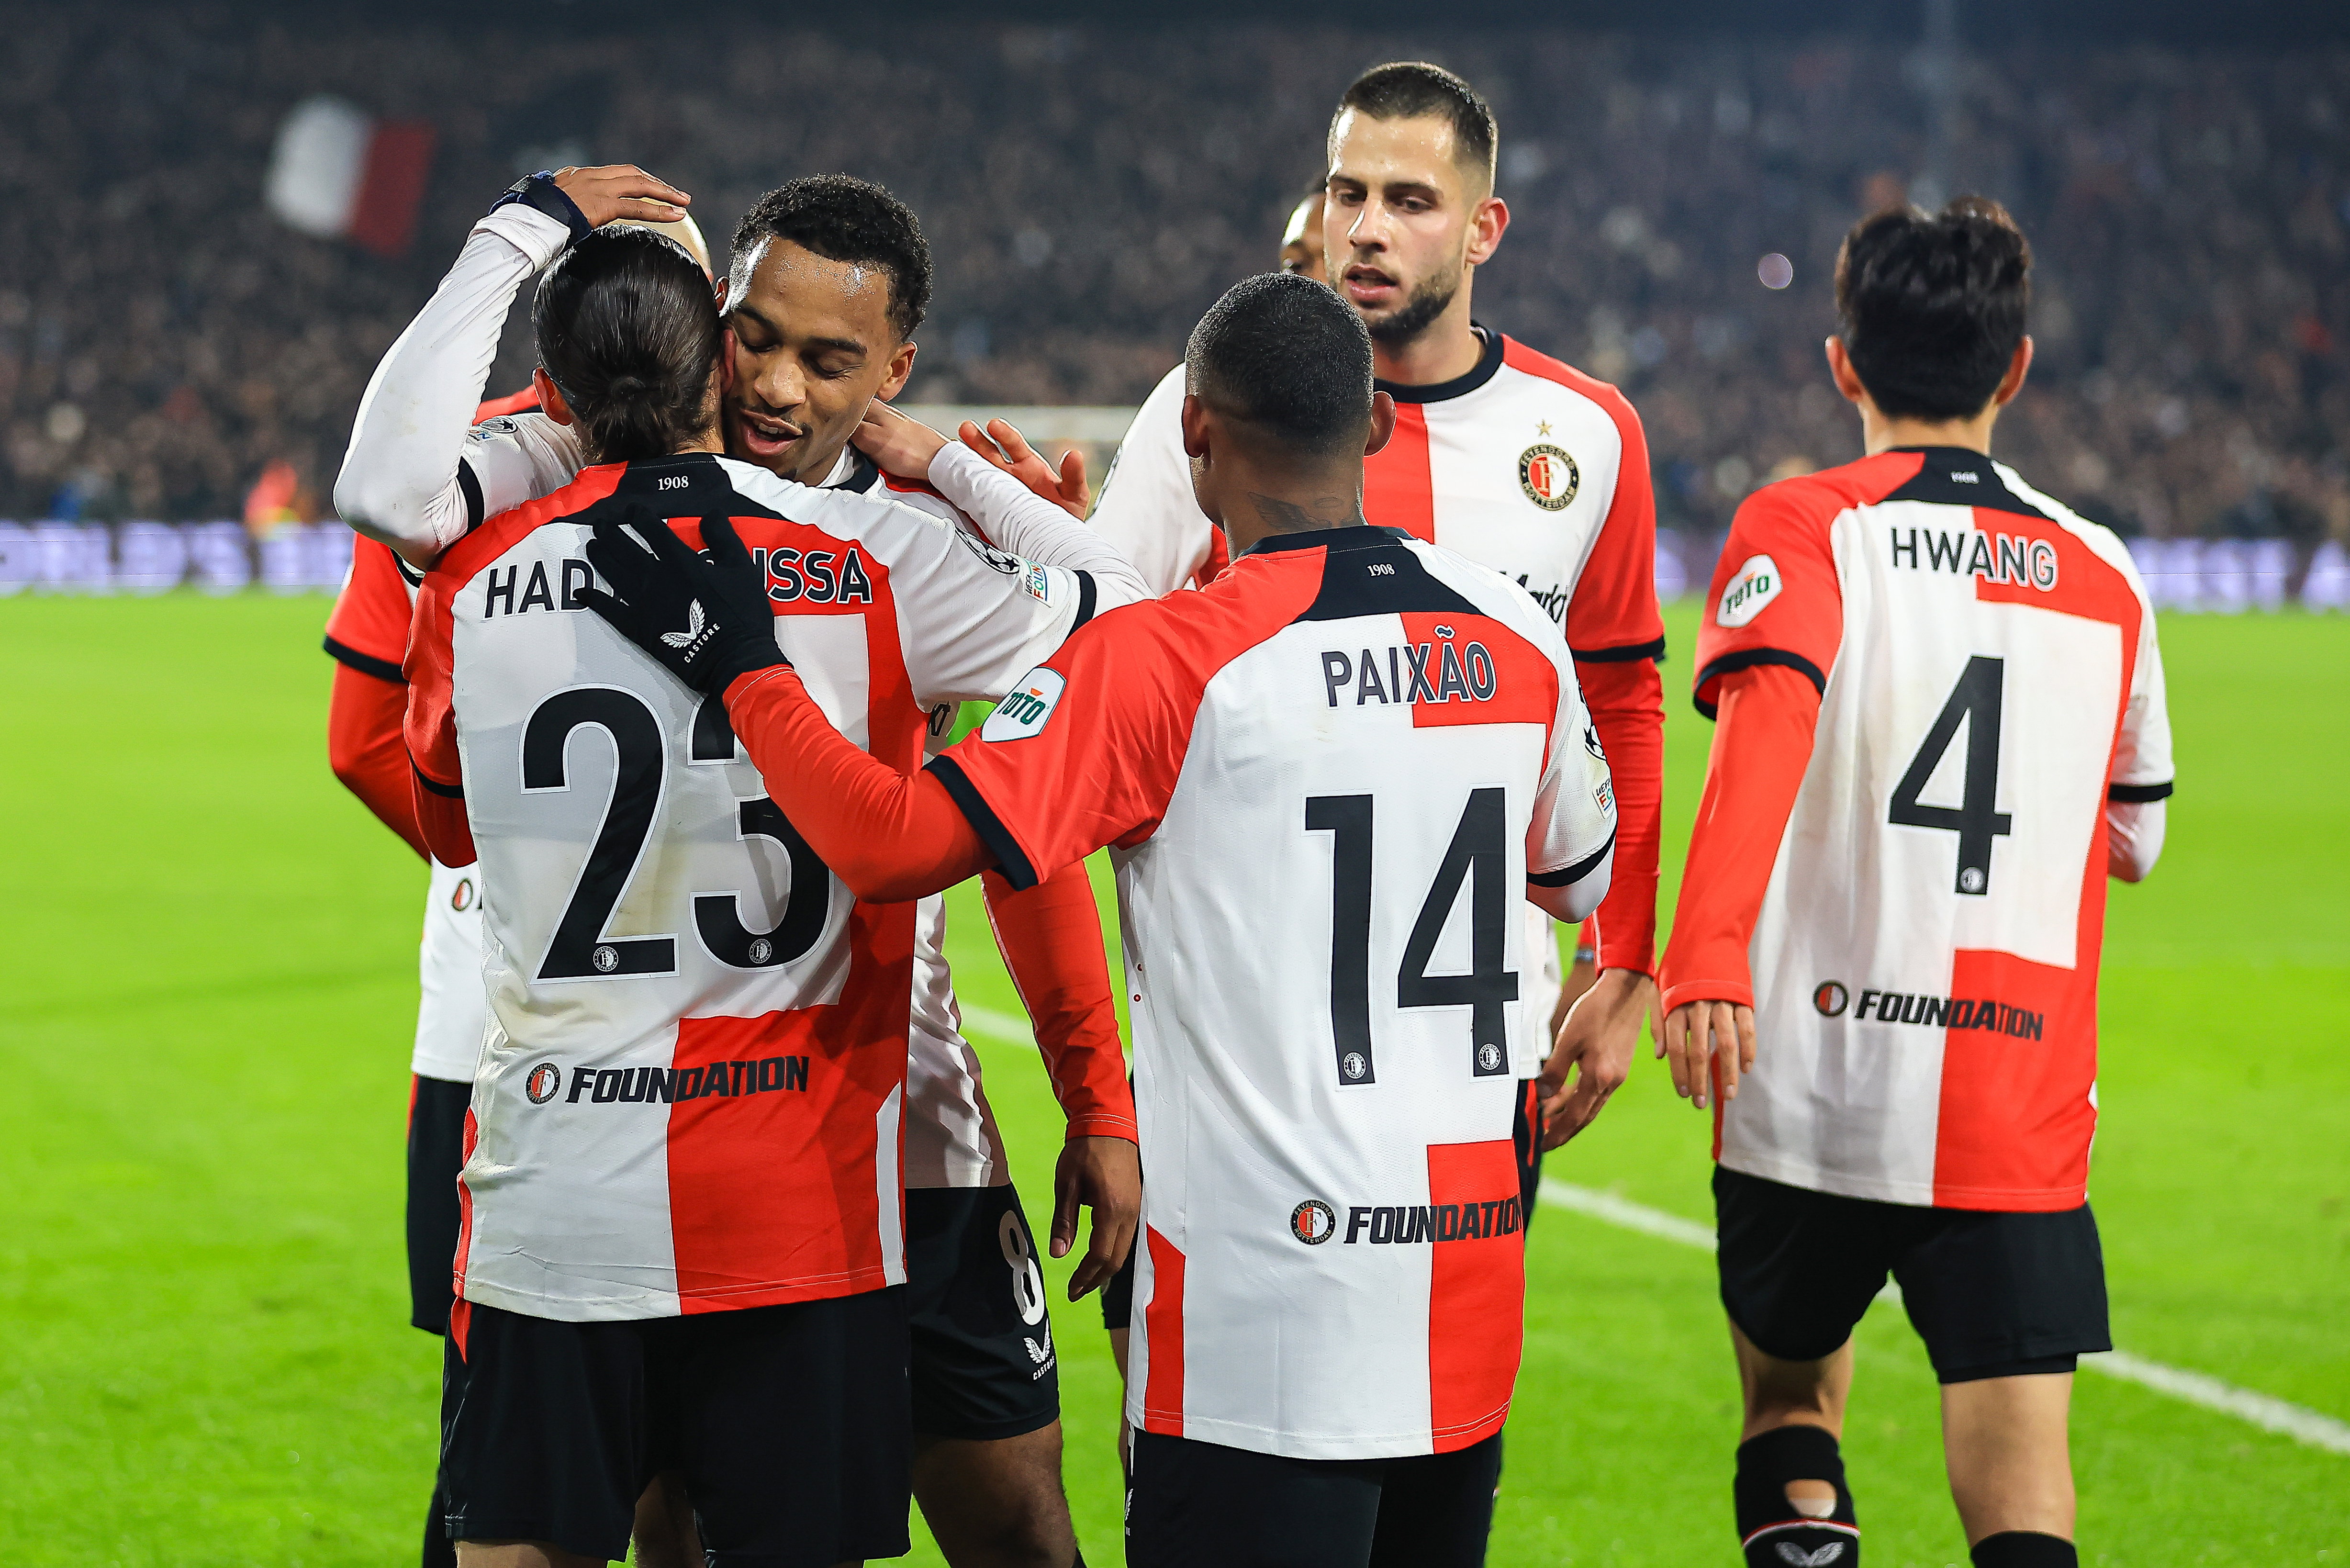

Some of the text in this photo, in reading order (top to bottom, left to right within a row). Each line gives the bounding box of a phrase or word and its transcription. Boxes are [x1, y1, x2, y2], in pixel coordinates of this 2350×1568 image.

[657, 475, 689, 491] 1908
[1367, 563, 1395, 577] 1908
[1891, 526, 2058, 592] HWANG
[483, 556, 596, 621] HAD
[1726, 574, 1769, 615] TOTO
[684, 623, 720, 663] CASTORE
[1321, 624, 1497, 710] PAIXÃO
[1888, 655, 2012, 895] 4
[518, 682, 835, 985] 23
[1301, 783, 1523, 1090] 14
[1854, 989, 2044, 1042] FOUNDATION
[530, 1064, 559, 1078] FEYENOORD
[565, 1056, 809, 1104] FOUNDATION
[527, 1089, 556, 1103] ROTTERDAM
[1294, 1201, 1332, 1217] FEYENOORD
[1343, 1193, 1522, 1244] FOUNDATION
[1294, 1228, 1332, 1243] ROTTERDAM
[999, 1210, 1045, 1326] 8
[1033, 1355, 1055, 1380] CASTORE
